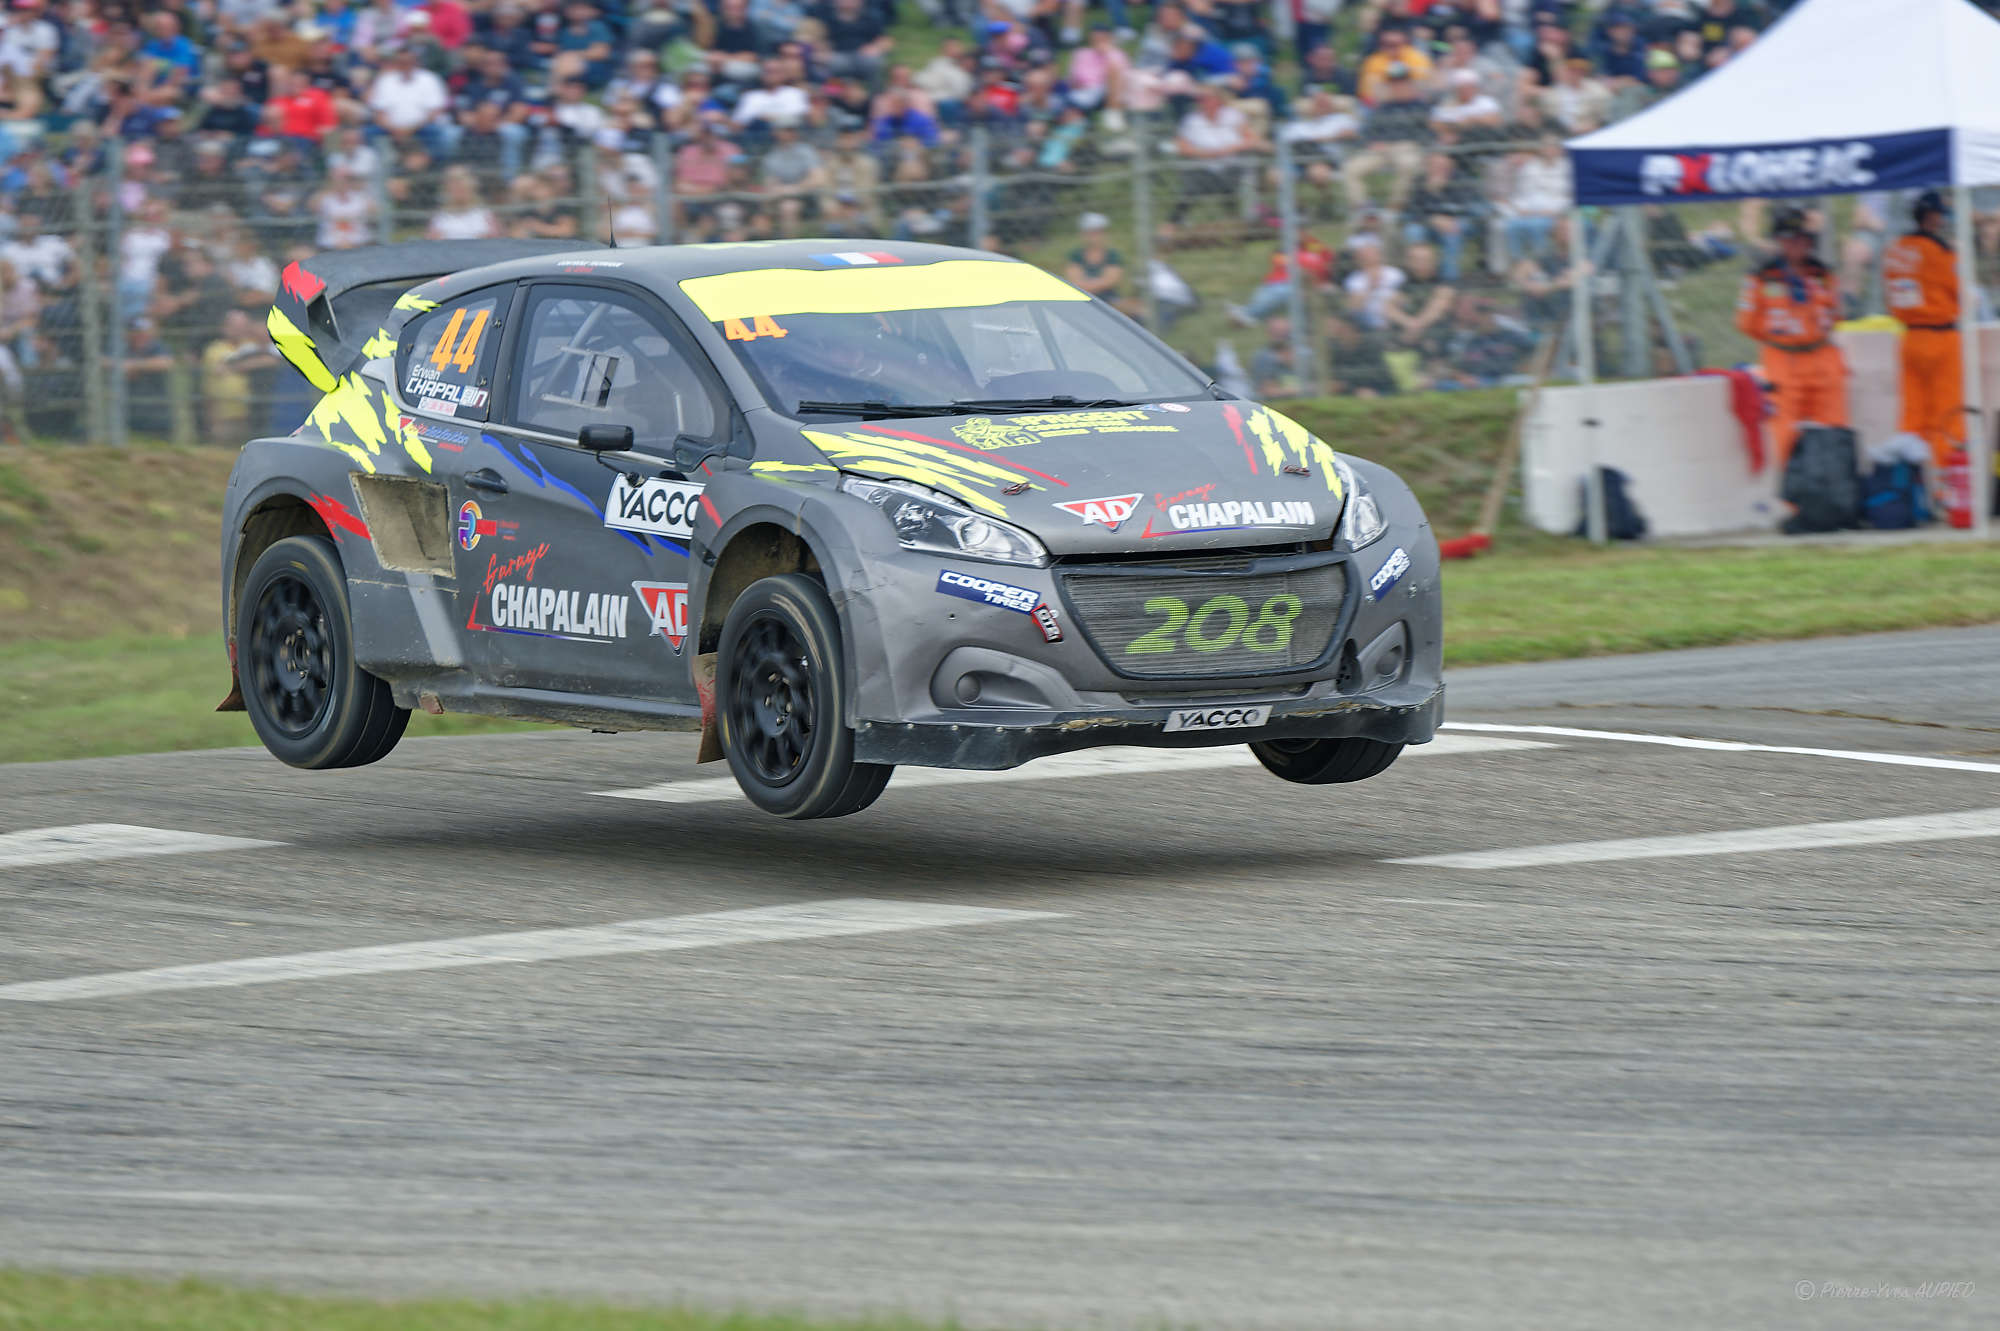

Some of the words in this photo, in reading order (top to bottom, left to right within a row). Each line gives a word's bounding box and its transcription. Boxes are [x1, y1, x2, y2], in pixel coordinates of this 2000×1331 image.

[430, 307, 491, 374] 44
[723, 316, 788, 341] 44
[412, 364, 441, 381] Erwan
[618, 486, 700, 528] YACCO
[1083, 501, 1133, 526] AD
[1168, 500, 1316, 529] CHAPALAIN
[483, 542, 550, 595] Garage
[940, 571, 1040, 604] COOPER
[984, 592, 1034, 613] TIRES
[491, 583, 629, 638] CHAPALAIN
[1125, 594, 1303, 655] 208
[1179, 709, 1260, 729] YACCO
